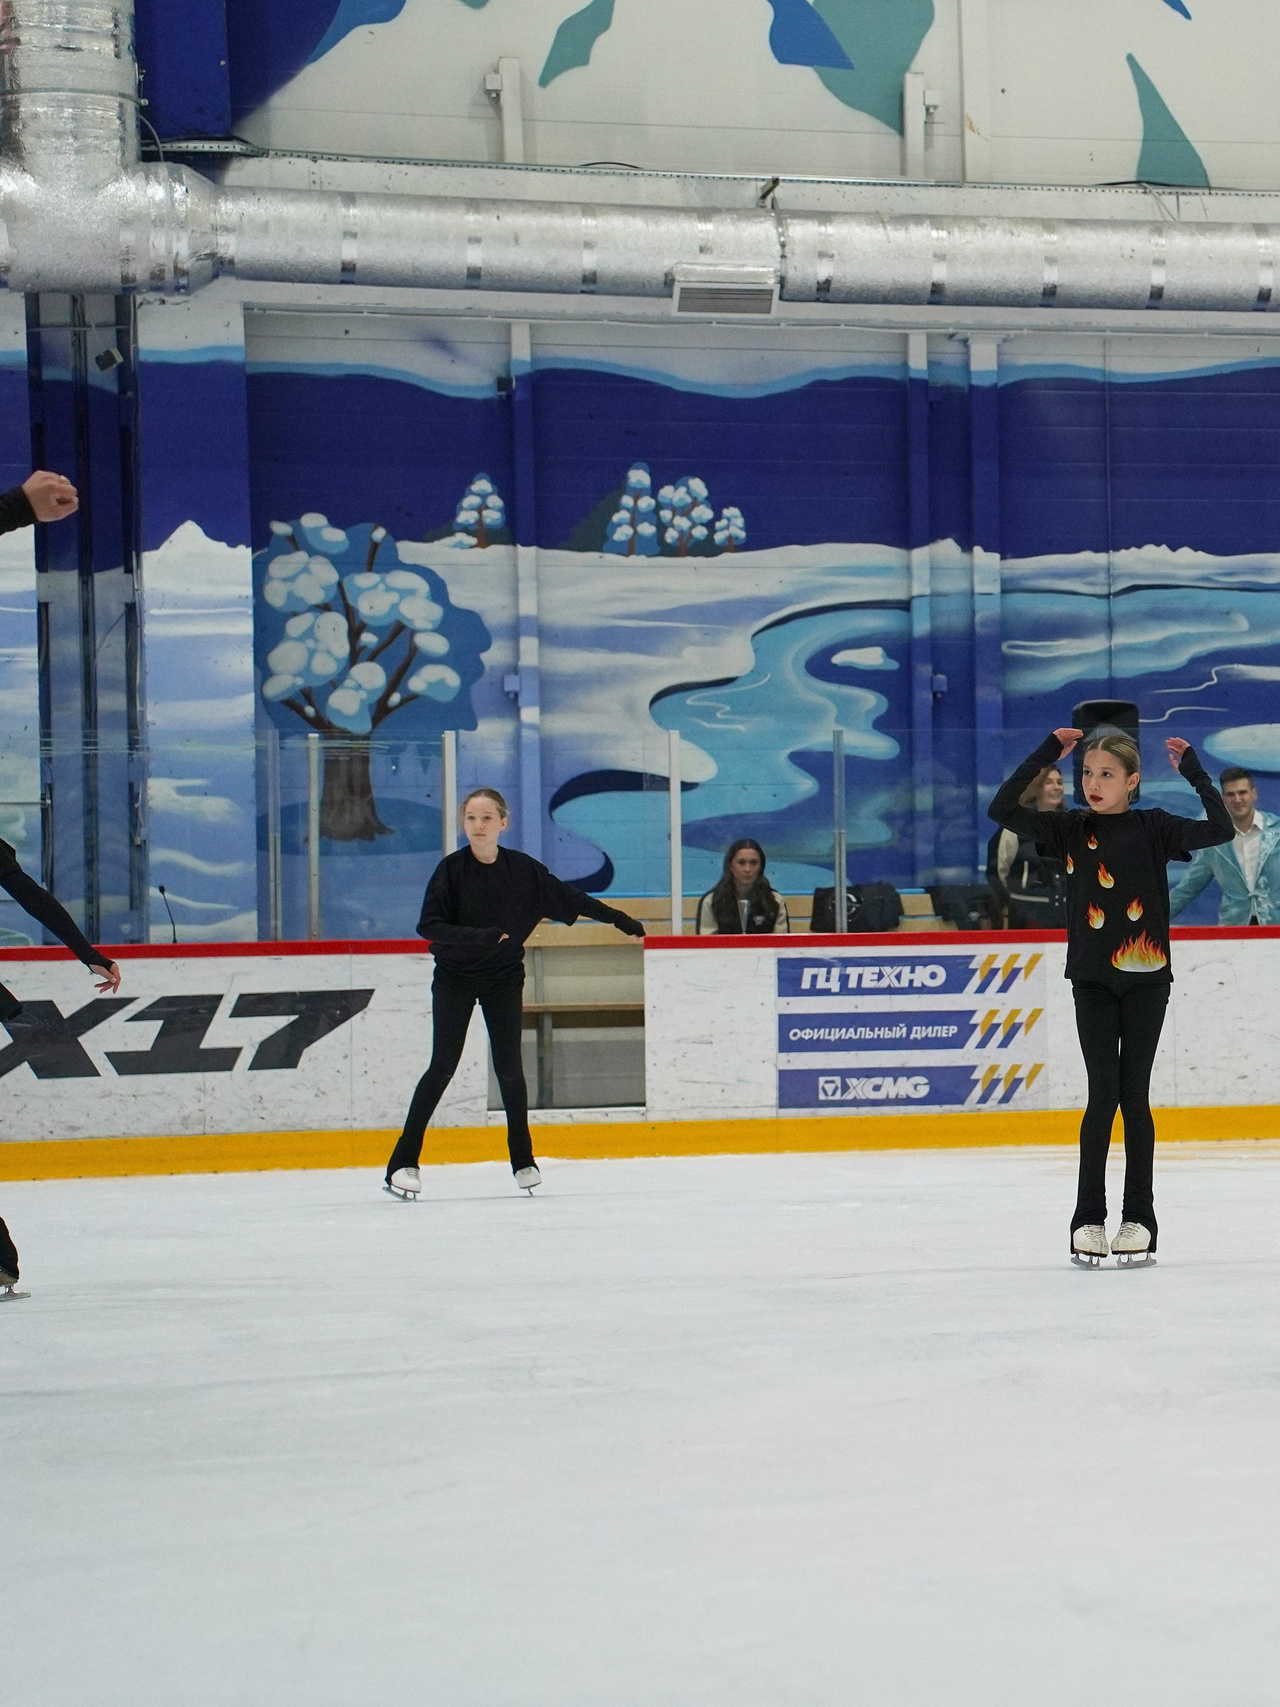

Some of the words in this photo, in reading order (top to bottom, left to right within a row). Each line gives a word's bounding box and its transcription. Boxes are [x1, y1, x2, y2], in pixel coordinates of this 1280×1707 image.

[800, 967, 840, 992] ГЦ
[845, 964, 947, 988] ТЕХНО
[789, 1023, 907, 1042] ОФИЦИАЛЬНЫЙ
[909, 1025, 958, 1040] ДИЛЕР
[841, 1076, 930, 1100] XCMG
